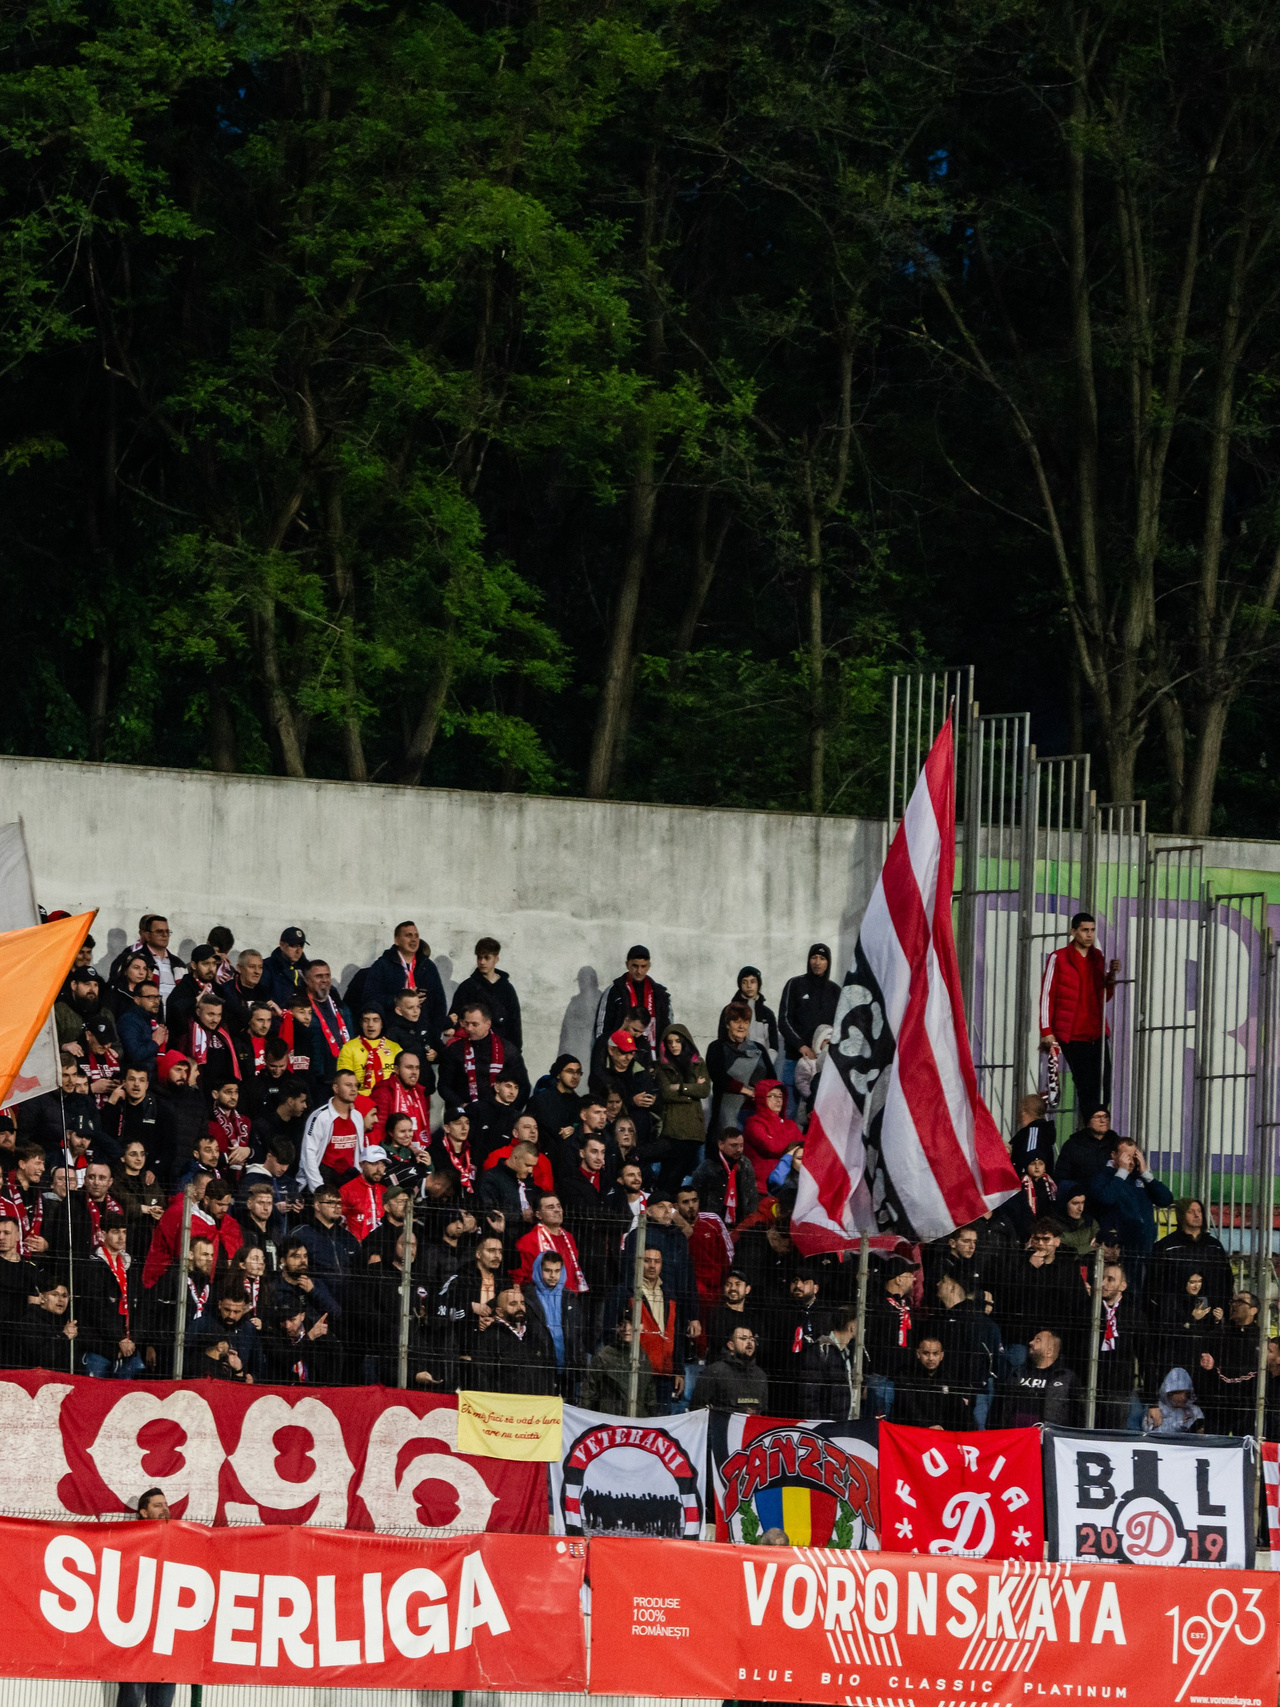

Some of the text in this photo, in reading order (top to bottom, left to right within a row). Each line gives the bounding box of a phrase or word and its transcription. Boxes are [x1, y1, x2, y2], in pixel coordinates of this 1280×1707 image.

[574, 1425, 686, 1471] VETERANII
[895, 1444, 1030, 1513] FURIA
[39, 1534, 511, 1669] SUPERLIGA
[632, 1608, 666, 1622] 100%
[633, 1596, 681, 1609] PRODUSE
[743, 1561, 1127, 1646] VORONSKAYA
[738, 1668, 1127, 1698] BLUE BIO CLASSIC PLATINUM
